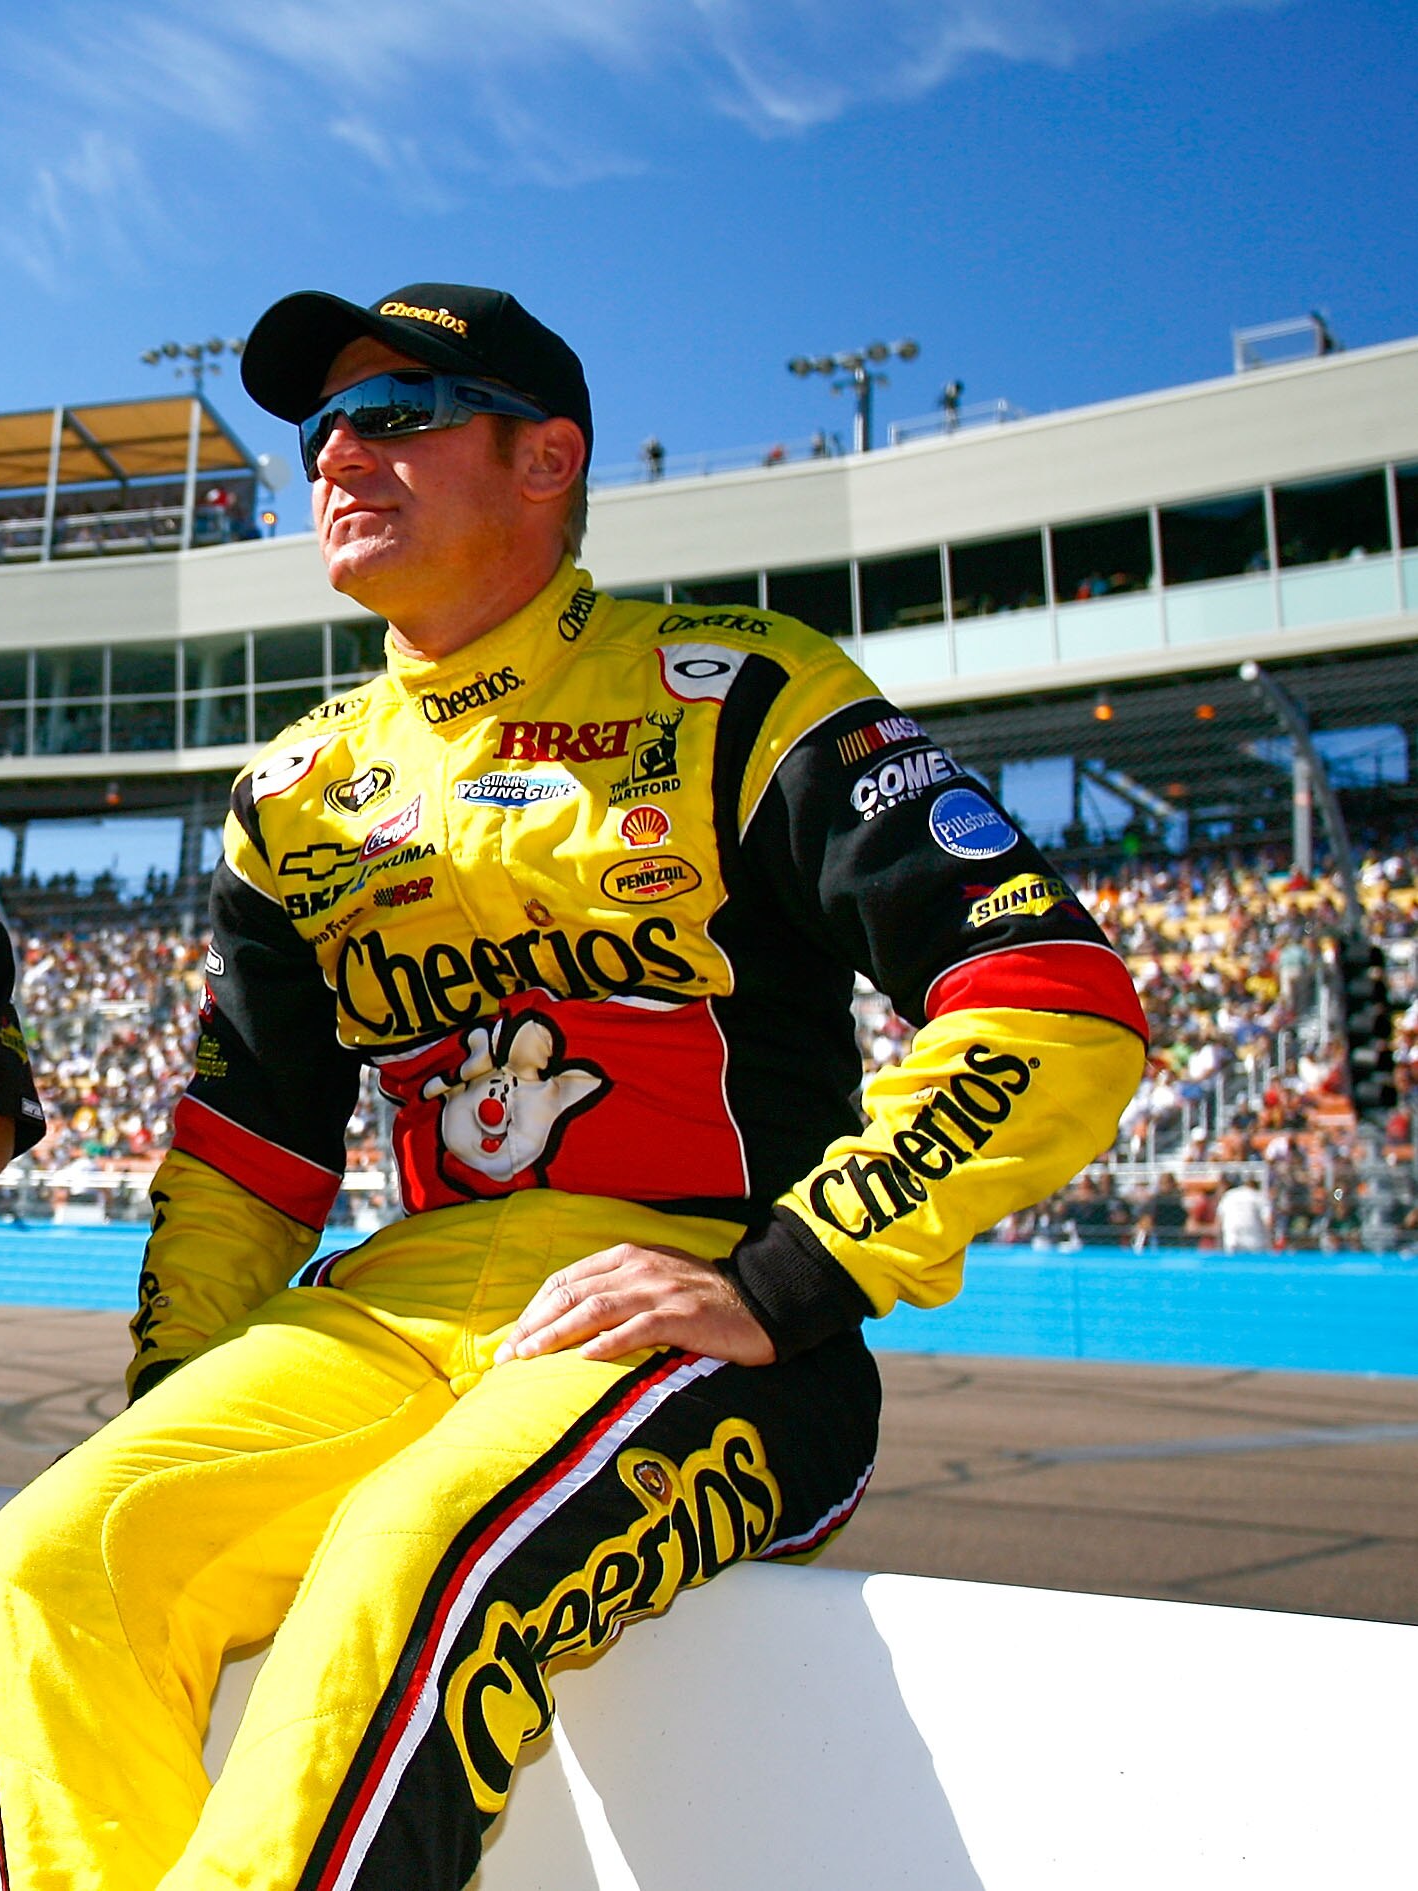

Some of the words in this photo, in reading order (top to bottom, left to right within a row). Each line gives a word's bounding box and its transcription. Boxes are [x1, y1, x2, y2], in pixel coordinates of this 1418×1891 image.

[380, 302, 468, 338] Cheerios
[422, 666, 526, 724] Cheerios
[493, 716, 642, 763] BB&T
[608, 777, 682, 808] HARTFORD
[610, 776, 631, 796] THE
[863, 789, 924, 822] GASKET
[936, 811, 1006, 844] Pillsbury
[284, 876, 355, 921] SKF
[616, 866, 688, 893] PENNZOIL
[309, 907, 365, 949] OODYEAR
[336, 917, 696, 1036] Cheerios
[809, 1044, 1031, 1242] Cheerios
[462, 1436, 776, 1794] Cheerios
